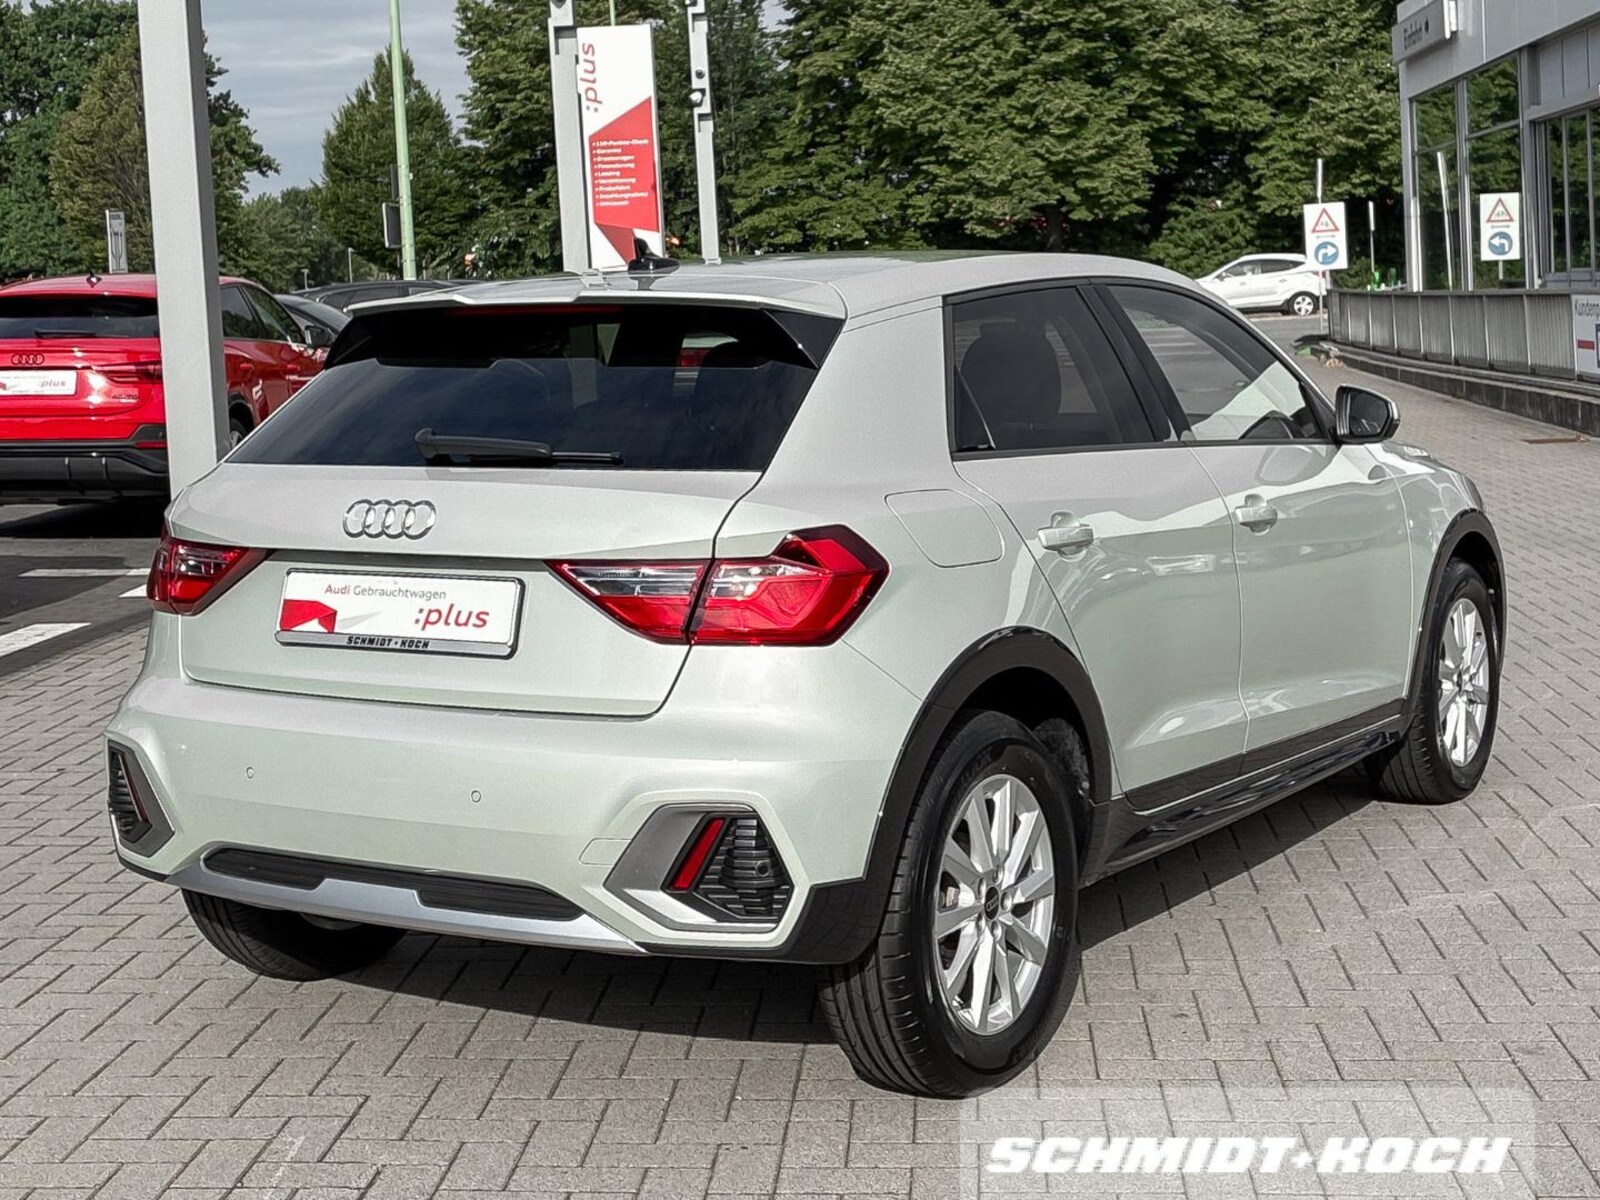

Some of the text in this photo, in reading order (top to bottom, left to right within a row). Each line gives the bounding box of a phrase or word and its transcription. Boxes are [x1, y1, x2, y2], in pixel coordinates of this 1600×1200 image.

[325, 584, 447, 600] Audi Gebrauchtwagen
[414, 603, 490, 632] :plus
